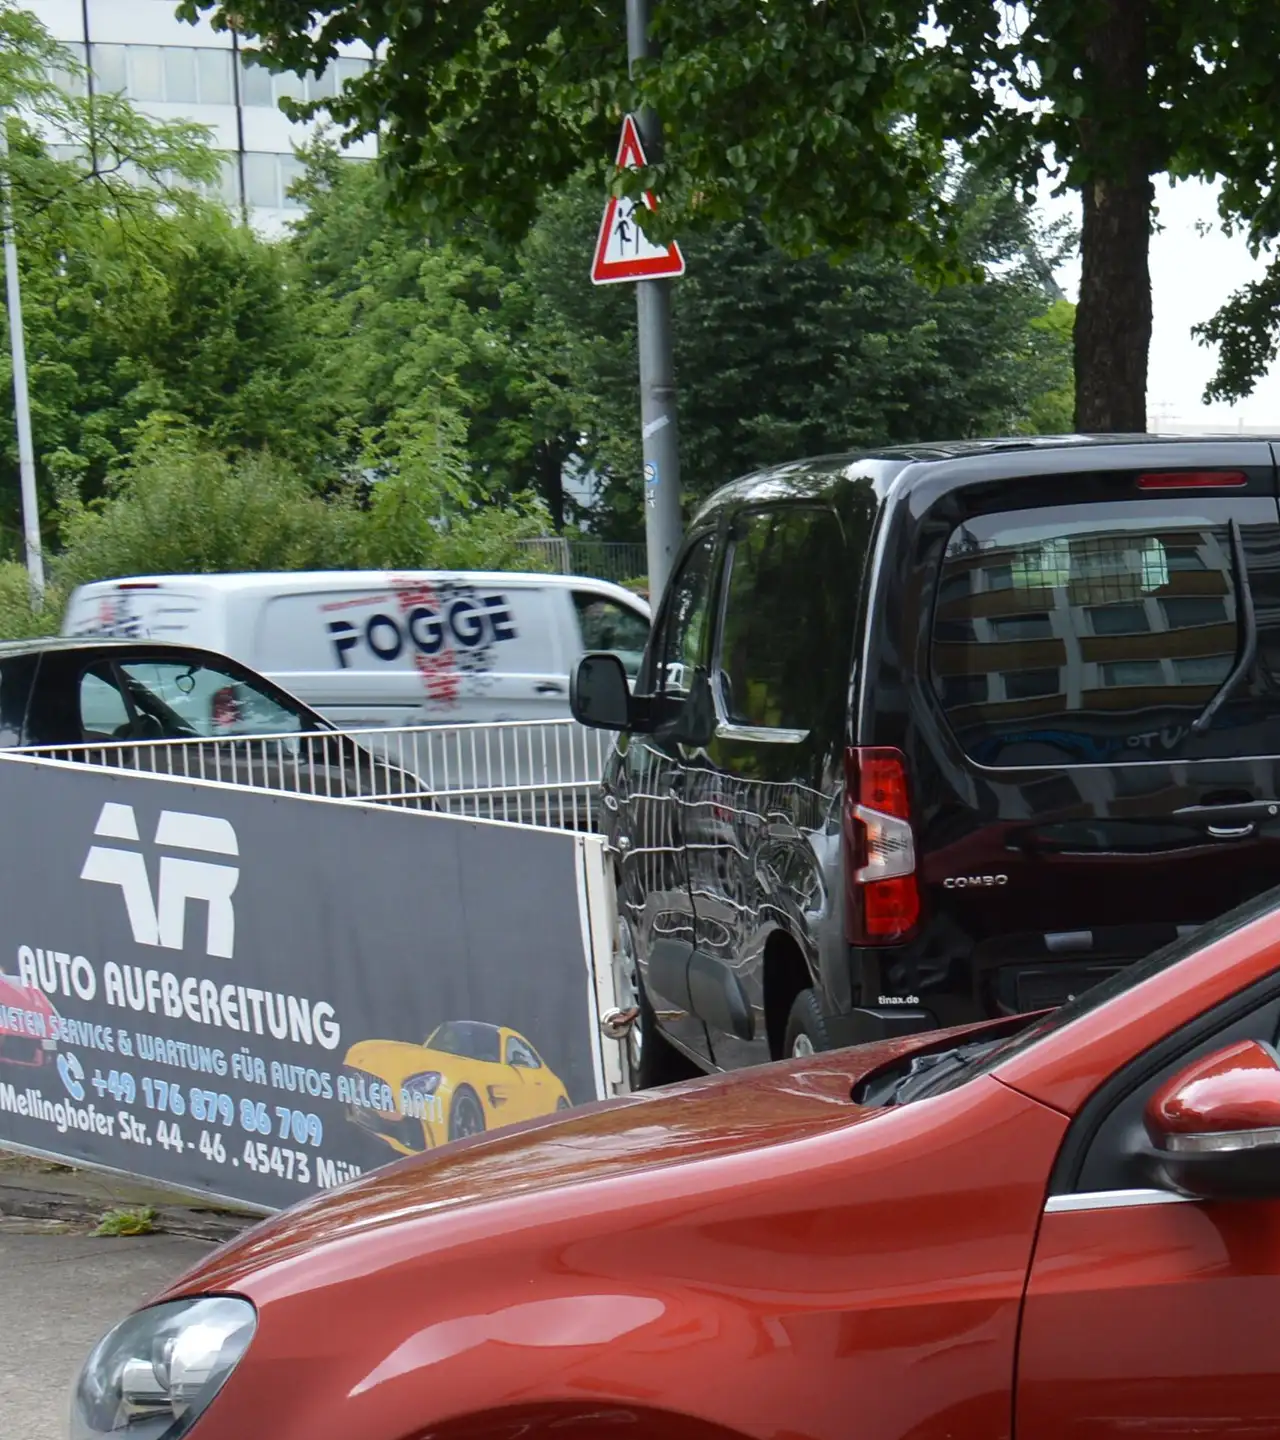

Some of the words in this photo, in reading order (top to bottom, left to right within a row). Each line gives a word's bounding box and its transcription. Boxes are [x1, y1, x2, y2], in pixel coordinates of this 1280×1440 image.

[327, 594, 519, 669] POGGE
[942, 874, 1009, 889] COMBO
[18, 944, 97, 1001] AUTO
[103, 960, 341, 1051] AUFBEREITUNG
[878, 994, 920, 1005] tinax.de
[0, 1003, 47, 1038] IETEN
[49, 1014, 116, 1053] SERVICE
[117, 1028, 135, 1057] &
[135, 1032, 229, 1078] WARTUNG
[231, 1046, 268, 1086] FÜR
[271, 1060, 334, 1100] AUTOS
[337, 1074, 397, 1113] ALLER
[400, 1087, 444, 1125] ART!
[0, 1081, 115, 1137] Mellinghofer
[117, 1110, 153, 1146] Str.
[156, 1119, 184, 1154] 44
[199, 1130, 227, 1164] 46
[243, 1139, 311, 1184] 45473
[91, 1068, 137, 1104] +49
[141, 1076, 186, 1116] 176
[189, 1087, 235, 1127] 879
[240, 1098, 272, 1136] 86
[275, 1105, 324, 1147] 709
